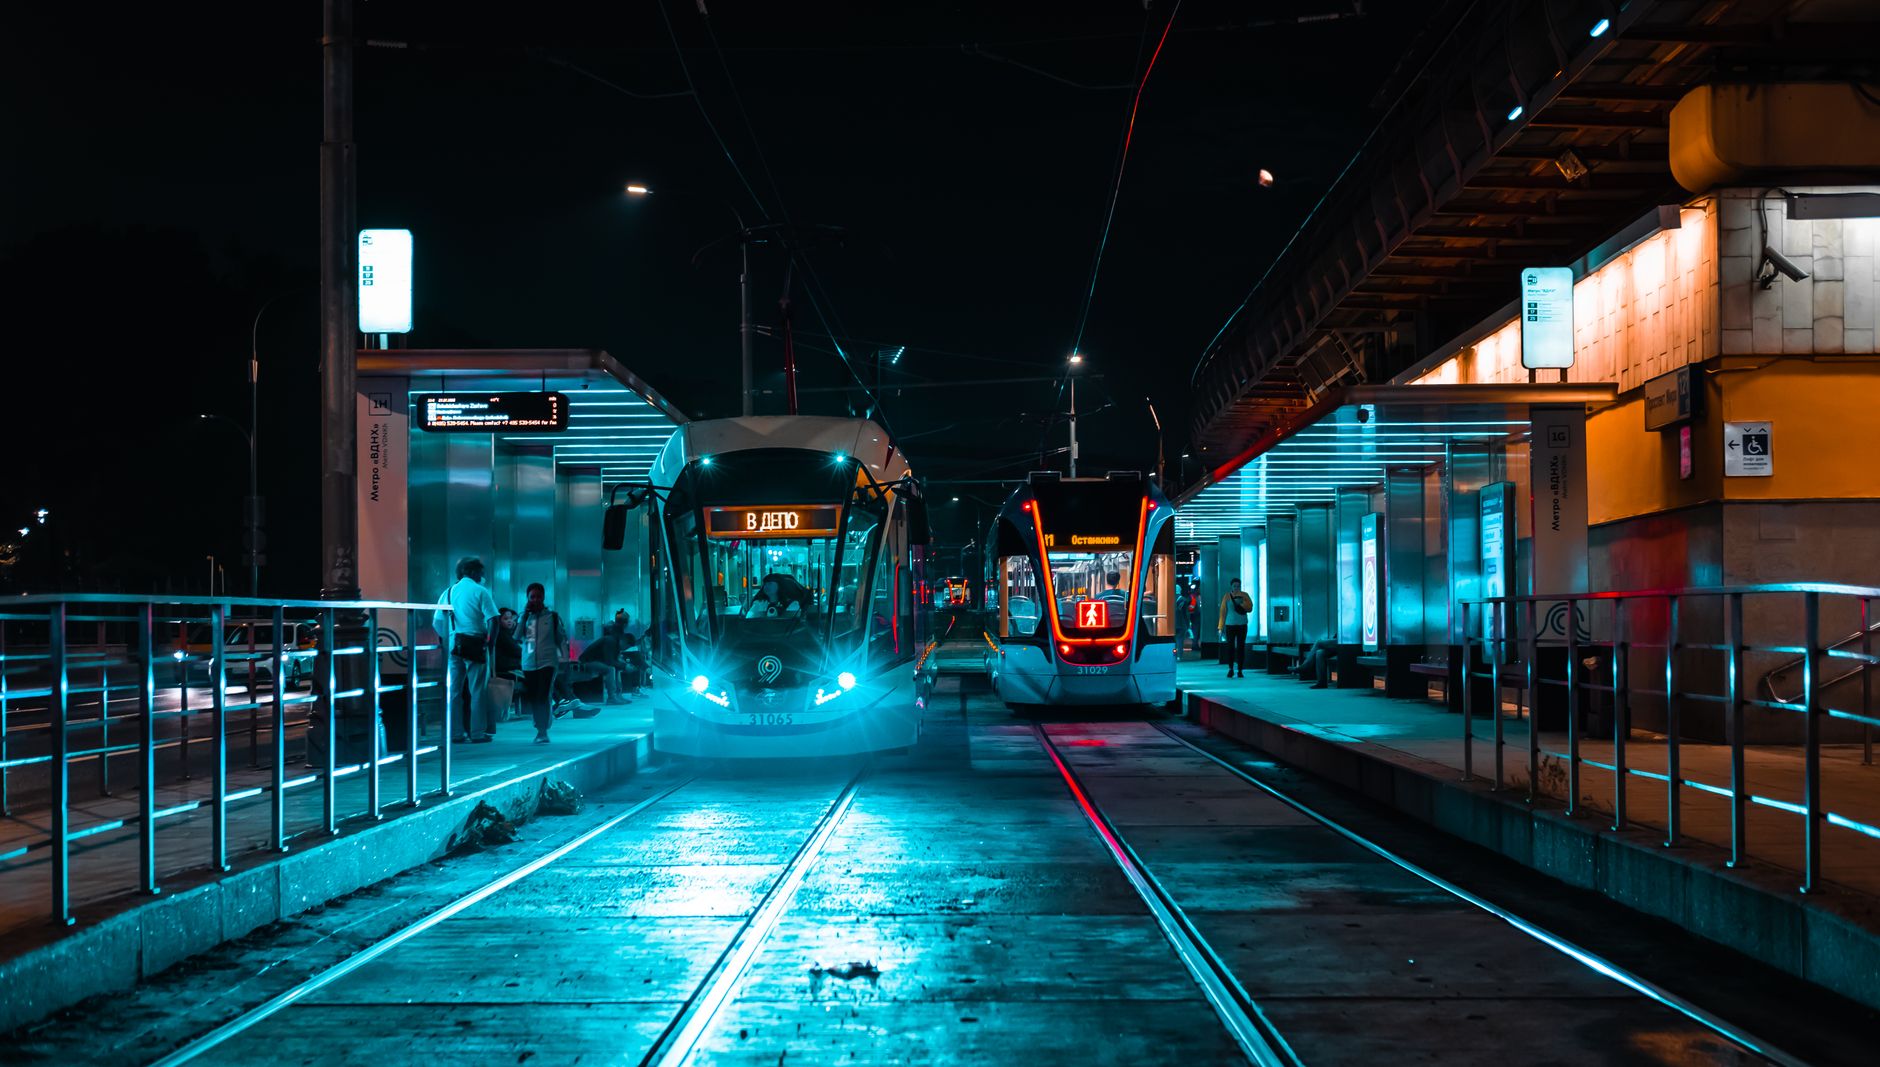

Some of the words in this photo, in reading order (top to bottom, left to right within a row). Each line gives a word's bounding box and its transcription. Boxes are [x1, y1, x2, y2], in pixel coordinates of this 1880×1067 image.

[370, 423, 380, 465] «ВДНХ»
[1552, 432, 1566, 441] 1G
[371, 468, 380, 502] Метро
[1550, 455, 1560, 496] «ВДНХ»
[746, 512, 757, 530] В
[759, 511, 799, 531] ДЕПО
[1551, 498, 1560, 532] Метро
[1071, 534, 1120, 545] Останкино
[1077, 666, 1109, 675] 31029
[749, 713, 793, 725] 31065
